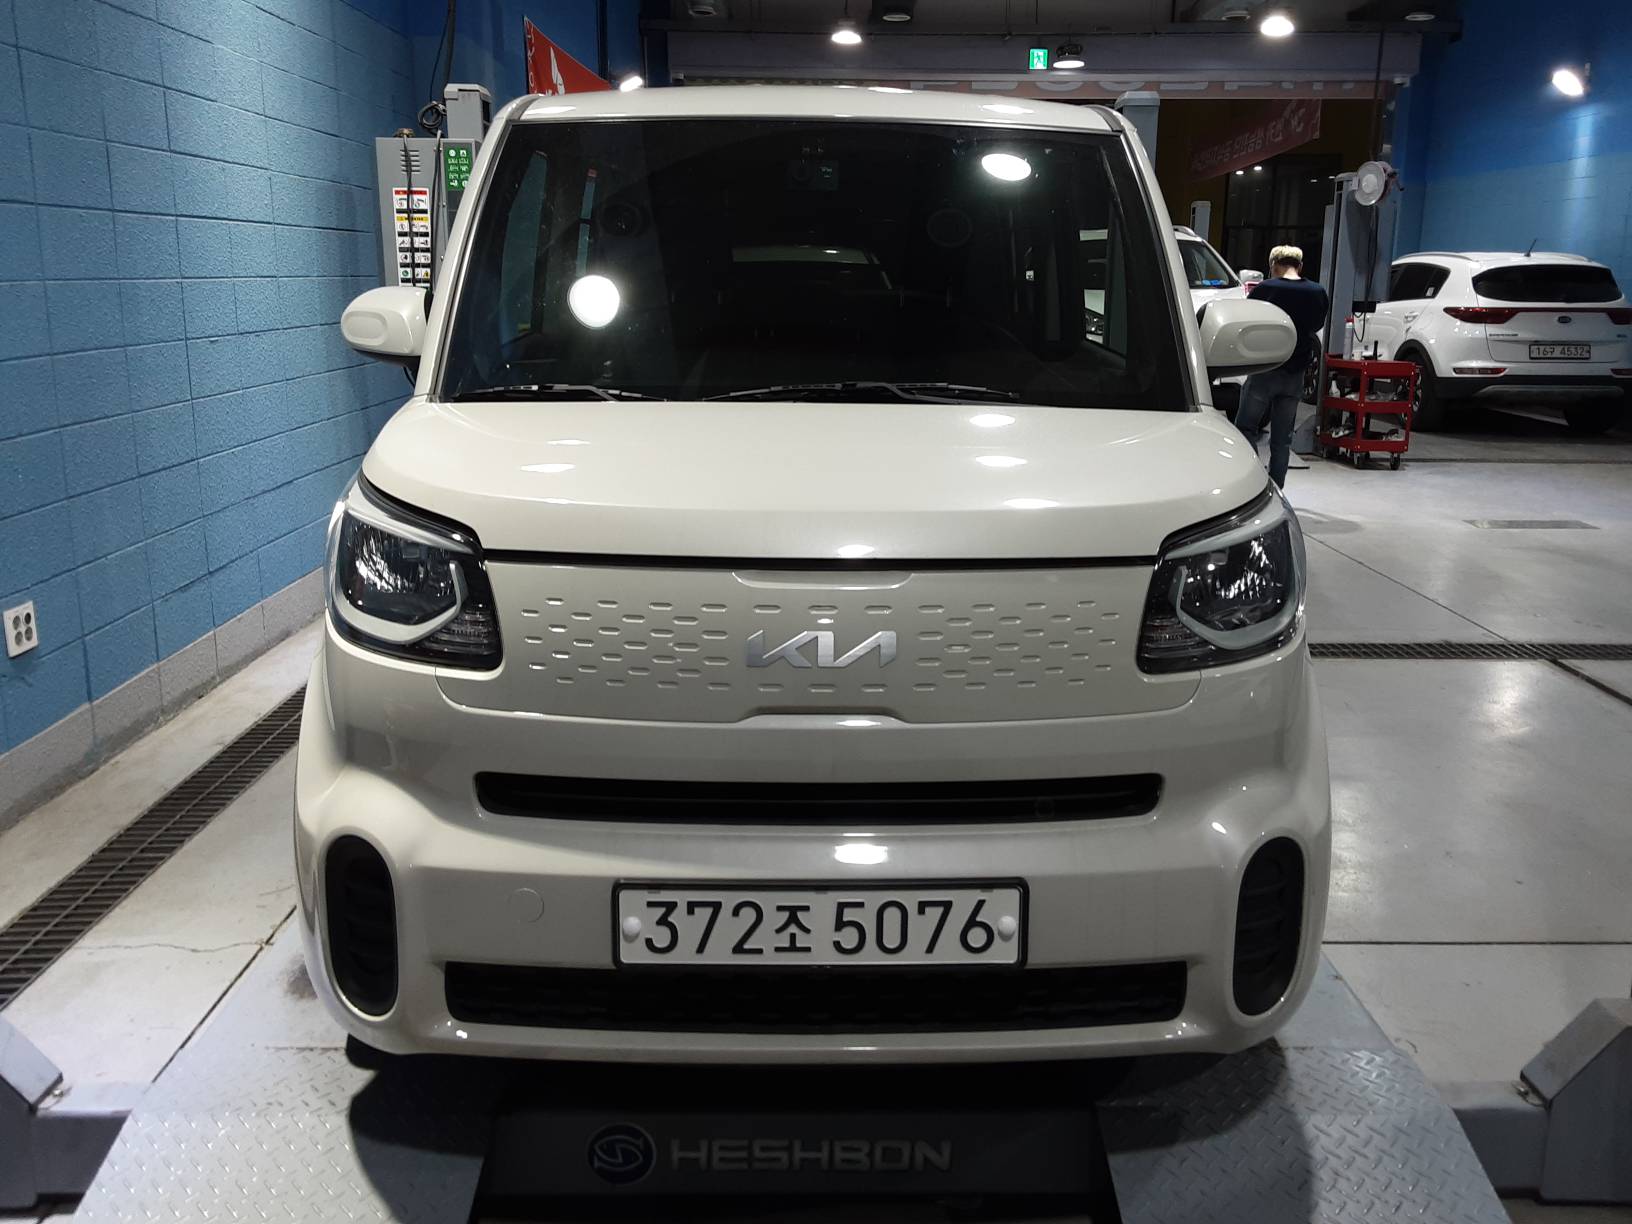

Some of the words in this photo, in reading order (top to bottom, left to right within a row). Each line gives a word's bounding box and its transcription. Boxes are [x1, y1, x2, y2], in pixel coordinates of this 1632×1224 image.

[1559, 346, 1585, 357] 4532
[644, 900, 813, 955] 372조
[832, 899, 996, 955] 5076
[670, 1138, 953, 1171] HESHBON
